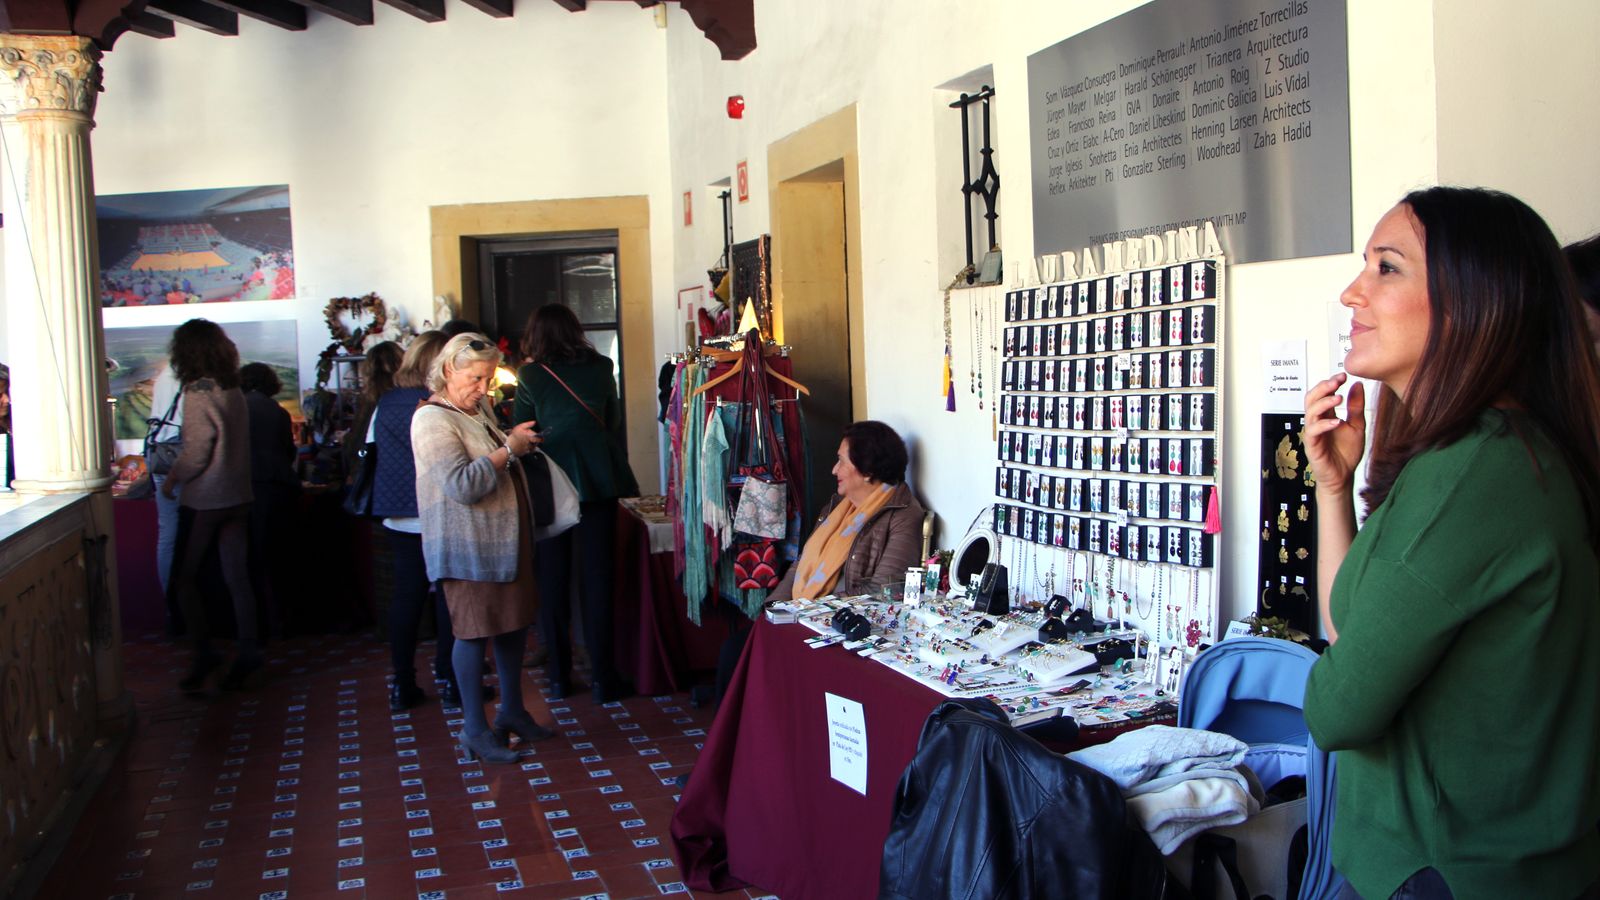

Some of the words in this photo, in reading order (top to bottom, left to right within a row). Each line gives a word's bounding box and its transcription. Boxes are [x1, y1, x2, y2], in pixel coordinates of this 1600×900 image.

[1045, 91, 1058, 105] Som
[1084, 70, 1117, 90] Consuegra
[1120, 56, 1156, 77] Dominique
[1156, 41, 1186, 64] Perrault
[1190, 29, 1222, 52] Antonio
[1223, 18, 1259, 41] Jiménez
[1260, 0, 1309, 27] Torrecillas
[1068, 99, 1087, 116] Mayer
[1094, 89, 1117, 106] Melgar
[1125, 76, 1147, 96] Harald
[1151, 63, 1197, 88] Schönegger
[1206, 48, 1242, 69] Trianera
[1246, 25, 1309, 56] Arquitectura
[1068, 117, 1095, 134] Francisco
[1099, 110, 1117, 125] Reina
[1126, 99, 1141, 116] GVA
[1153, 89, 1180, 108] Donaire
[1192, 74, 1224, 97] Antonio
[1231, 65, 1250, 85] Roig
[1265, 58, 1272, 75] Z
[1278, 48, 1310, 71] Studio
[1047, 146, 1060, 159] Cruz
[1065, 138, 1079, 154] Ortiz
[1103, 127, 1125, 143] A-Cero
[1129, 117, 1151, 136] Daniel
[1153, 106, 1186, 129] Libeskind
[1192, 97, 1226, 119] Dominic
[1227, 87, 1257, 109] Galicia
[1264, 80, 1283, 99] Luis
[1285, 71, 1310, 93] Vidal
[1048, 164, 1063, 179] Jorge
[1124, 142, 1139, 158] Enia
[1142, 133, 1183, 153] Architectes
[1191, 120, 1225, 141] Henning
[1229, 113, 1258, 132] Larsen
[1262, 98, 1312, 124] Architects
[1048, 180, 1066, 196] Reflex
[1068, 175, 1097, 192] Arkitekter
[1122, 160, 1153, 179] Gonzalez
[1157, 152, 1186, 171] Sterling
[1197, 137, 1241, 162] Woodhead
[1253, 131, 1277, 150] Zaha
[1283, 121, 1312, 143] Hadid
[1010, 247, 1099, 291] LAURA
[1102, 221, 1225, 275] MEDINA
[1089, 231, 1109, 246] THANKS
[1109, 231, 1119, 242] FOR
[1119, 227, 1149, 242] DESIGNING
[1215, 213, 1233, 228] WITH
[1235, 211, 1247, 225] MP
